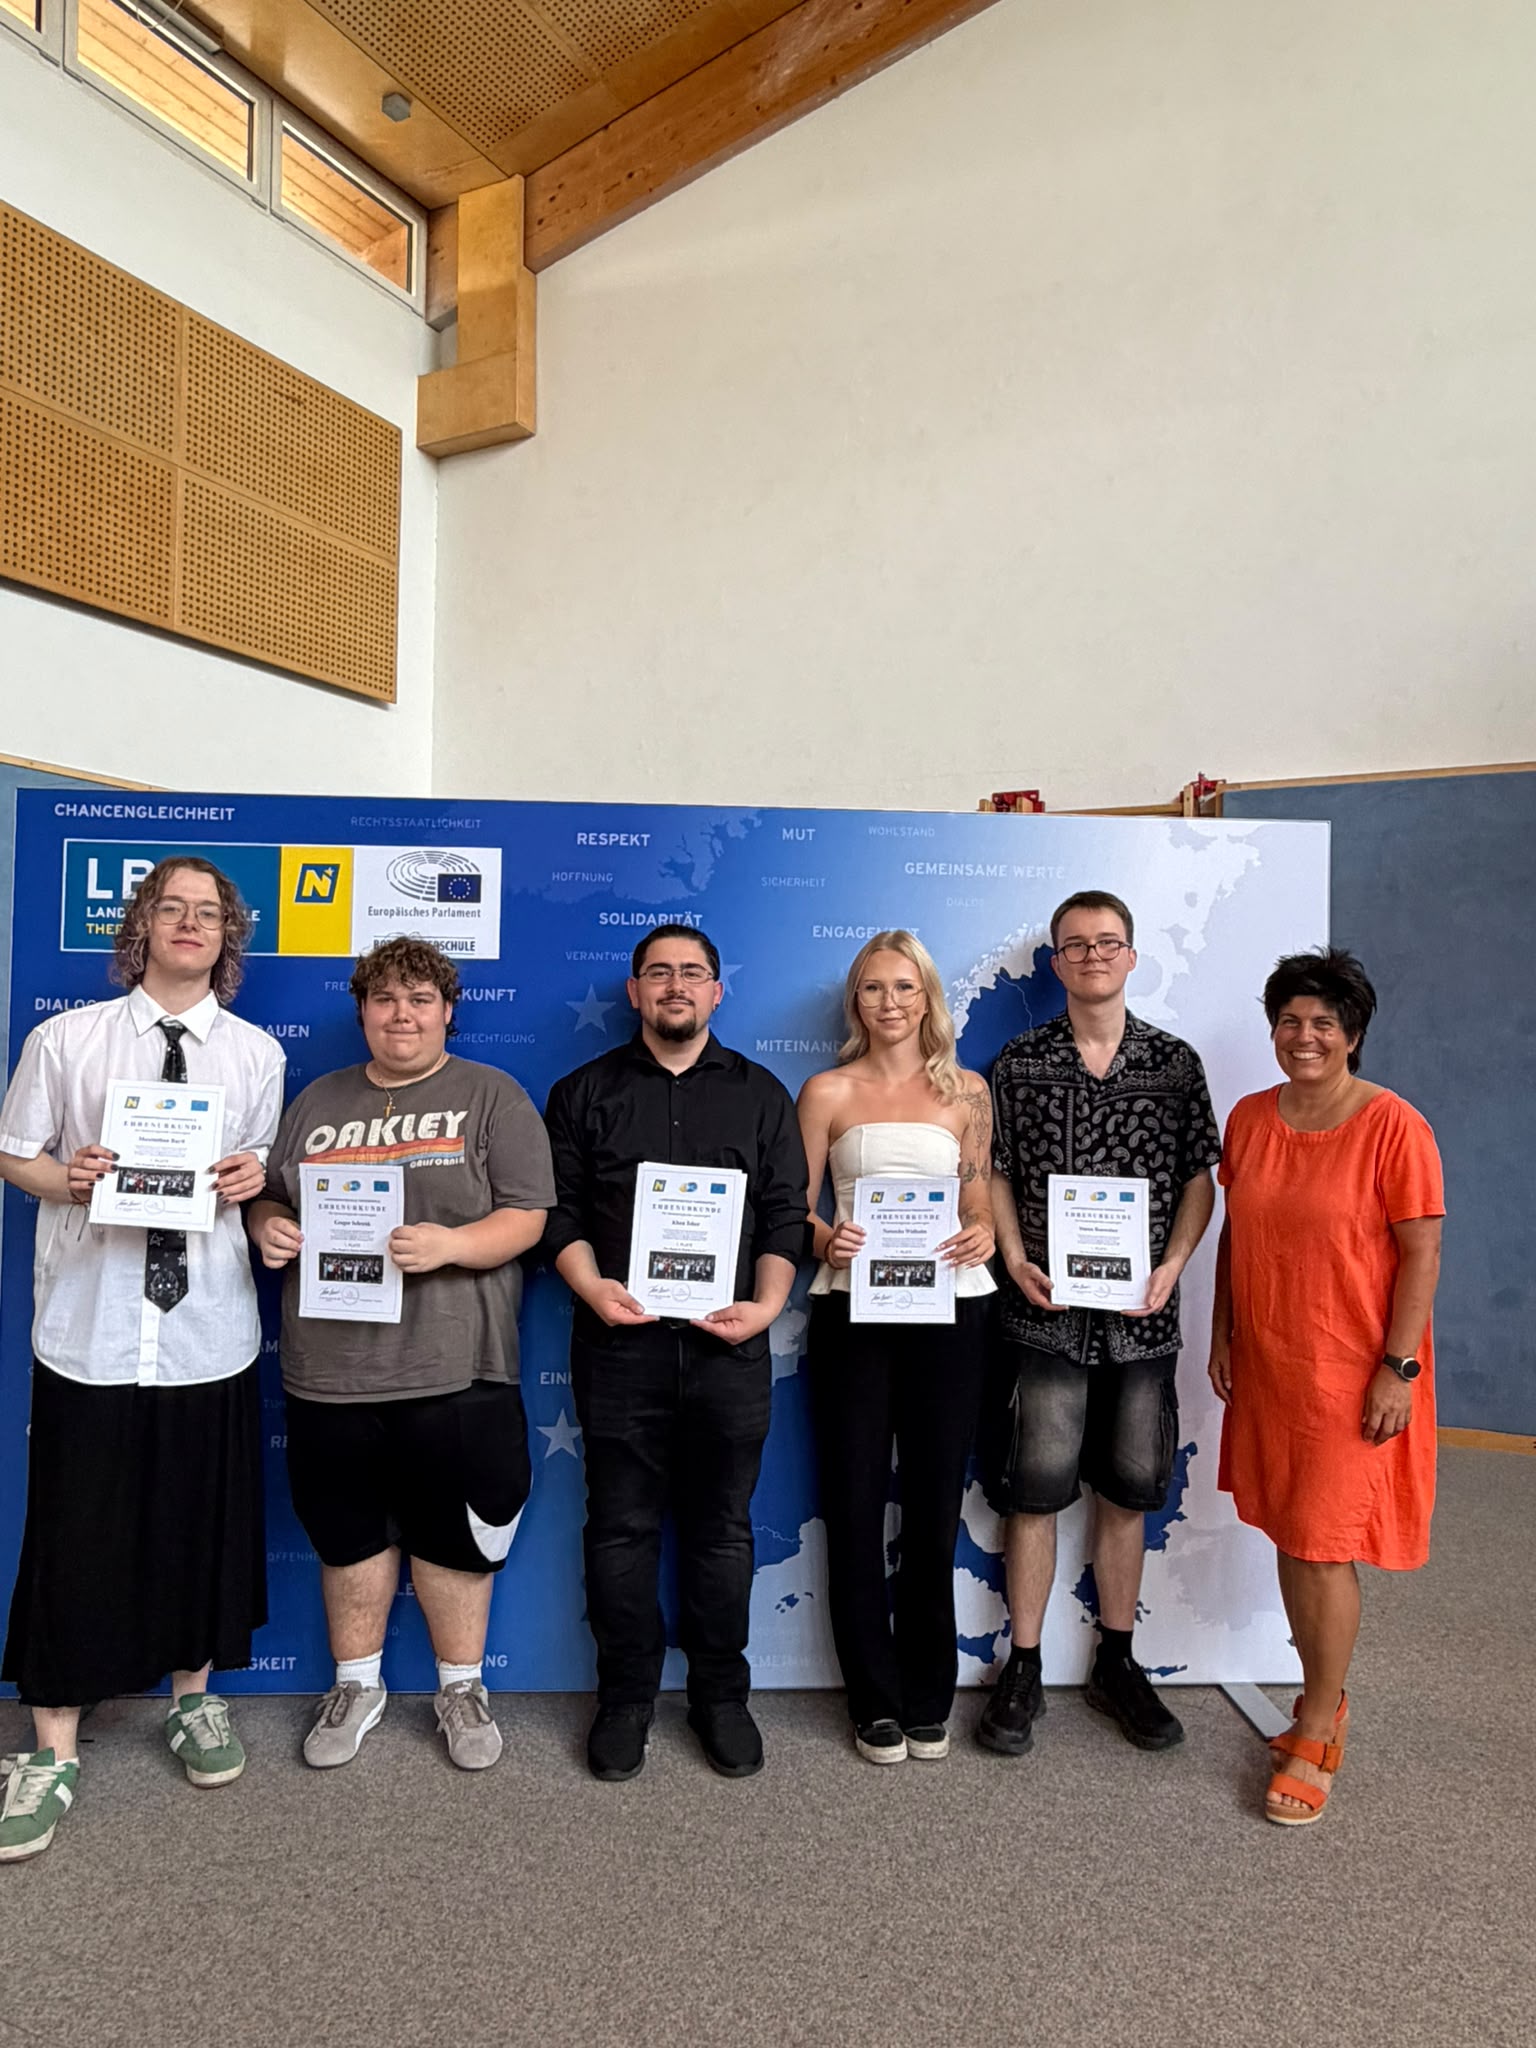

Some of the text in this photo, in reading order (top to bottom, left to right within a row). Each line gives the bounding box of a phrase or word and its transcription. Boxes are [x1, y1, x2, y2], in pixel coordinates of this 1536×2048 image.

[54, 803, 235, 821] CHANCENGLEICHHEIT
[350, 816, 482, 829] RECHTSSTAATLICHKEIT
[781, 828, 816, 841] MUT
[868, 826, 935, 838] WOHLSTAND
[576, 832, 651, 847] RESPEKT
[904, 861, 1066, 879] GEMEINSAME WERTE
[87, 857, 156, 900] LB
[552, 872, 614, 883] HOFFNUNG
[761, 876, 827, 888] SICHERHEIT
[367, 906, 482, 919] Europäisches Parlament
[599, 911, 703, 927] SOLIDARITÄT
[460, 987, 517, 1002] KUNFT
[304, 1110, 469, 1155] OAKLEY
[409, 1156, 465, 1169] CALIFORNIA
